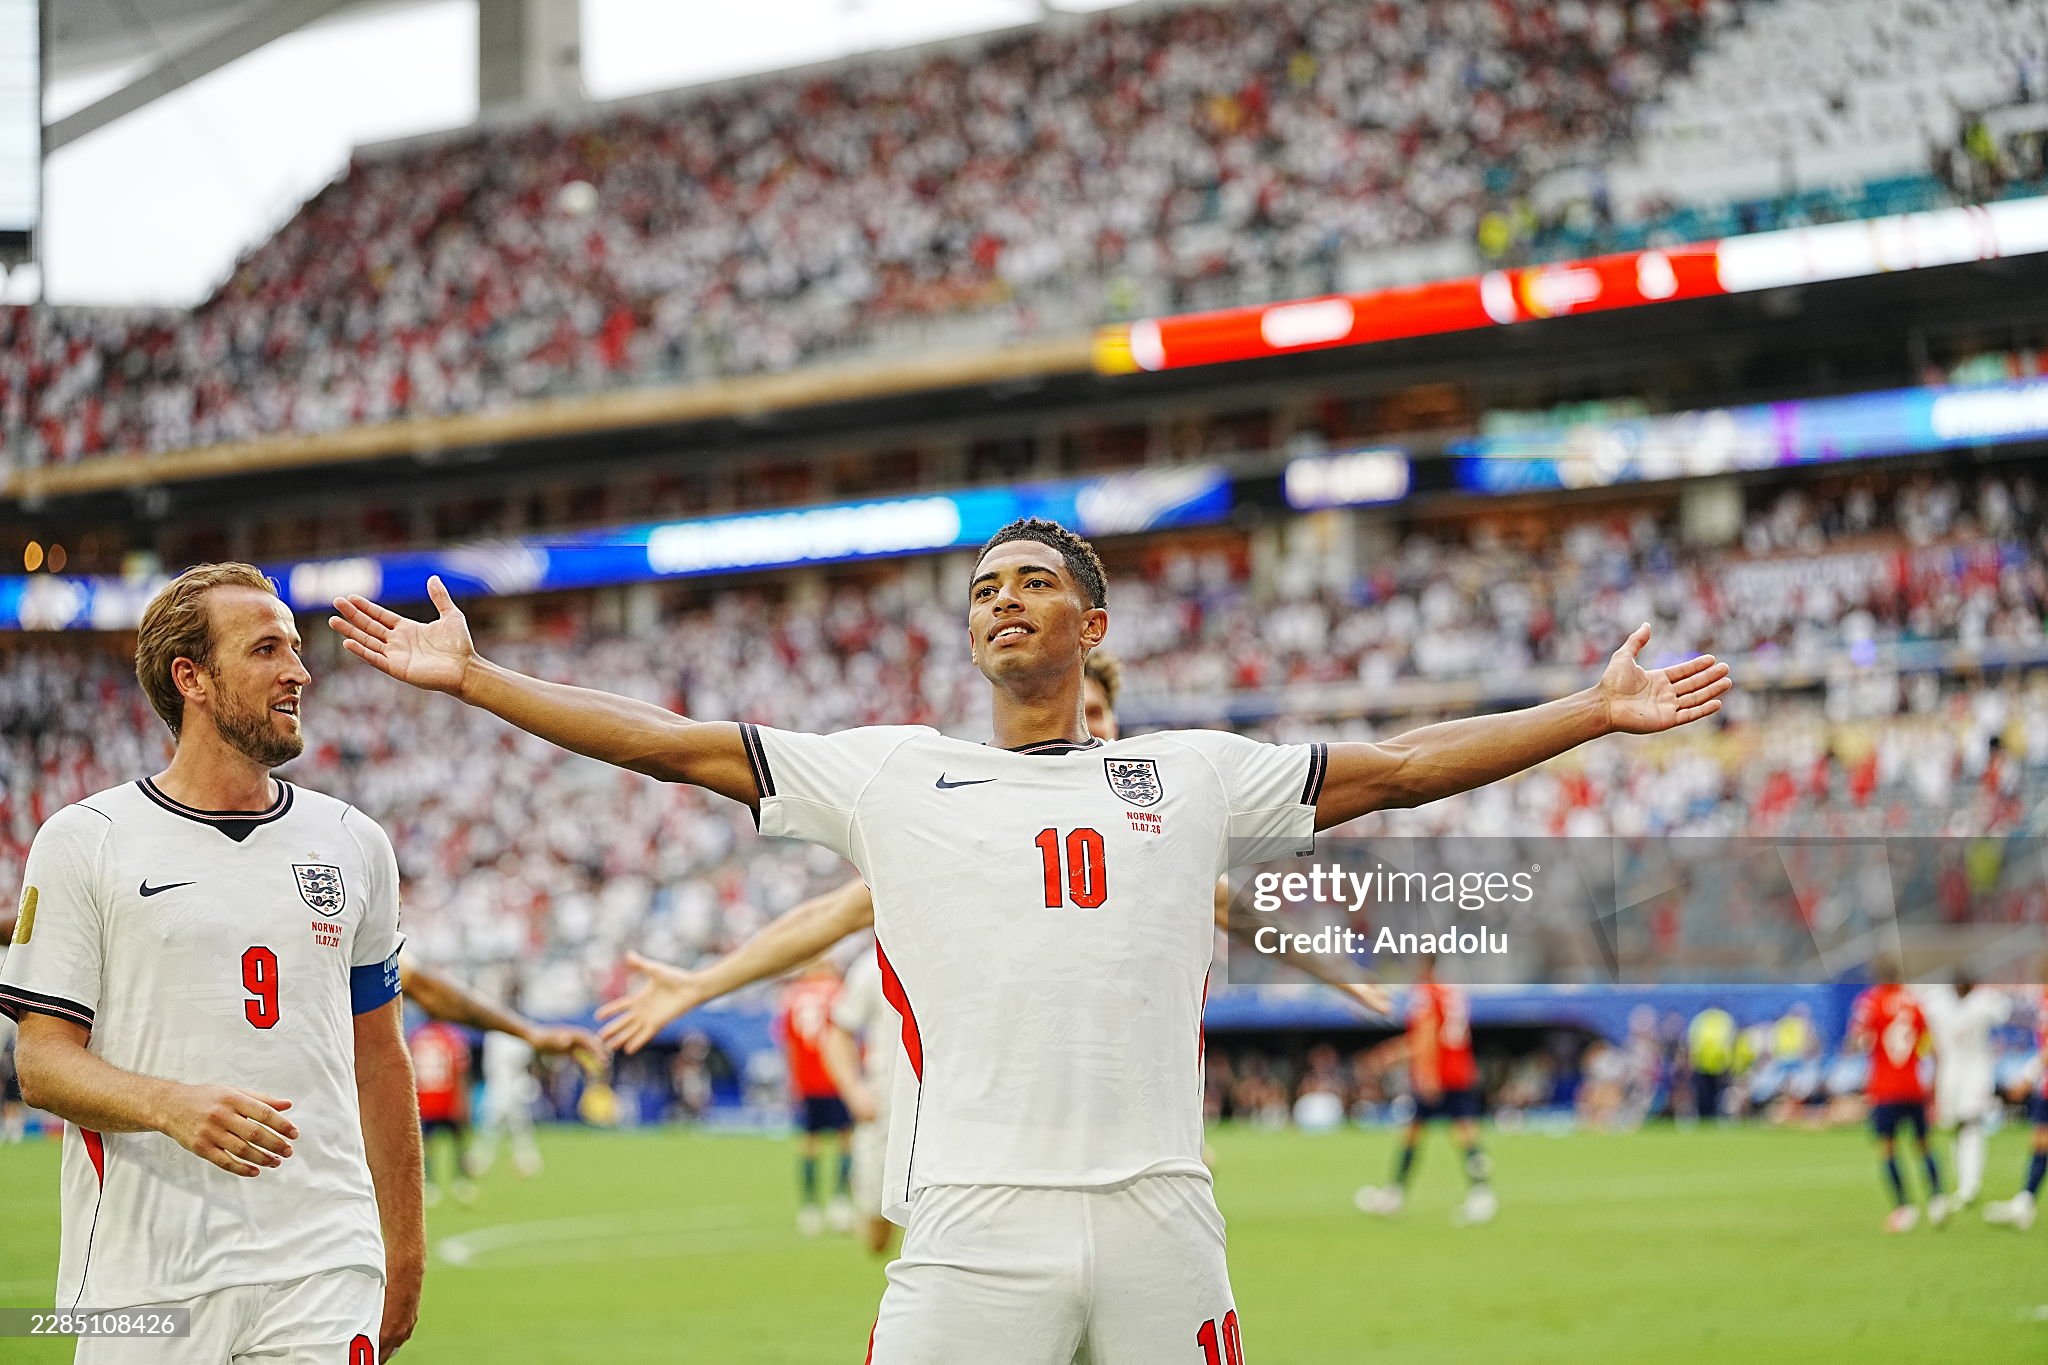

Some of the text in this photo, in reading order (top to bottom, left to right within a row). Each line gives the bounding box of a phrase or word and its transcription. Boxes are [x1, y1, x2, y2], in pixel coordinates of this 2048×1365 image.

[1126, 811, 1162, 823] NORWAY
[1131, 822, 1161, 834] 11.07.26
[1035, 827, 1108, 909] 10
[311, 921, 343, 936] NORWAY
[241, 945, 280, 1029] 9
